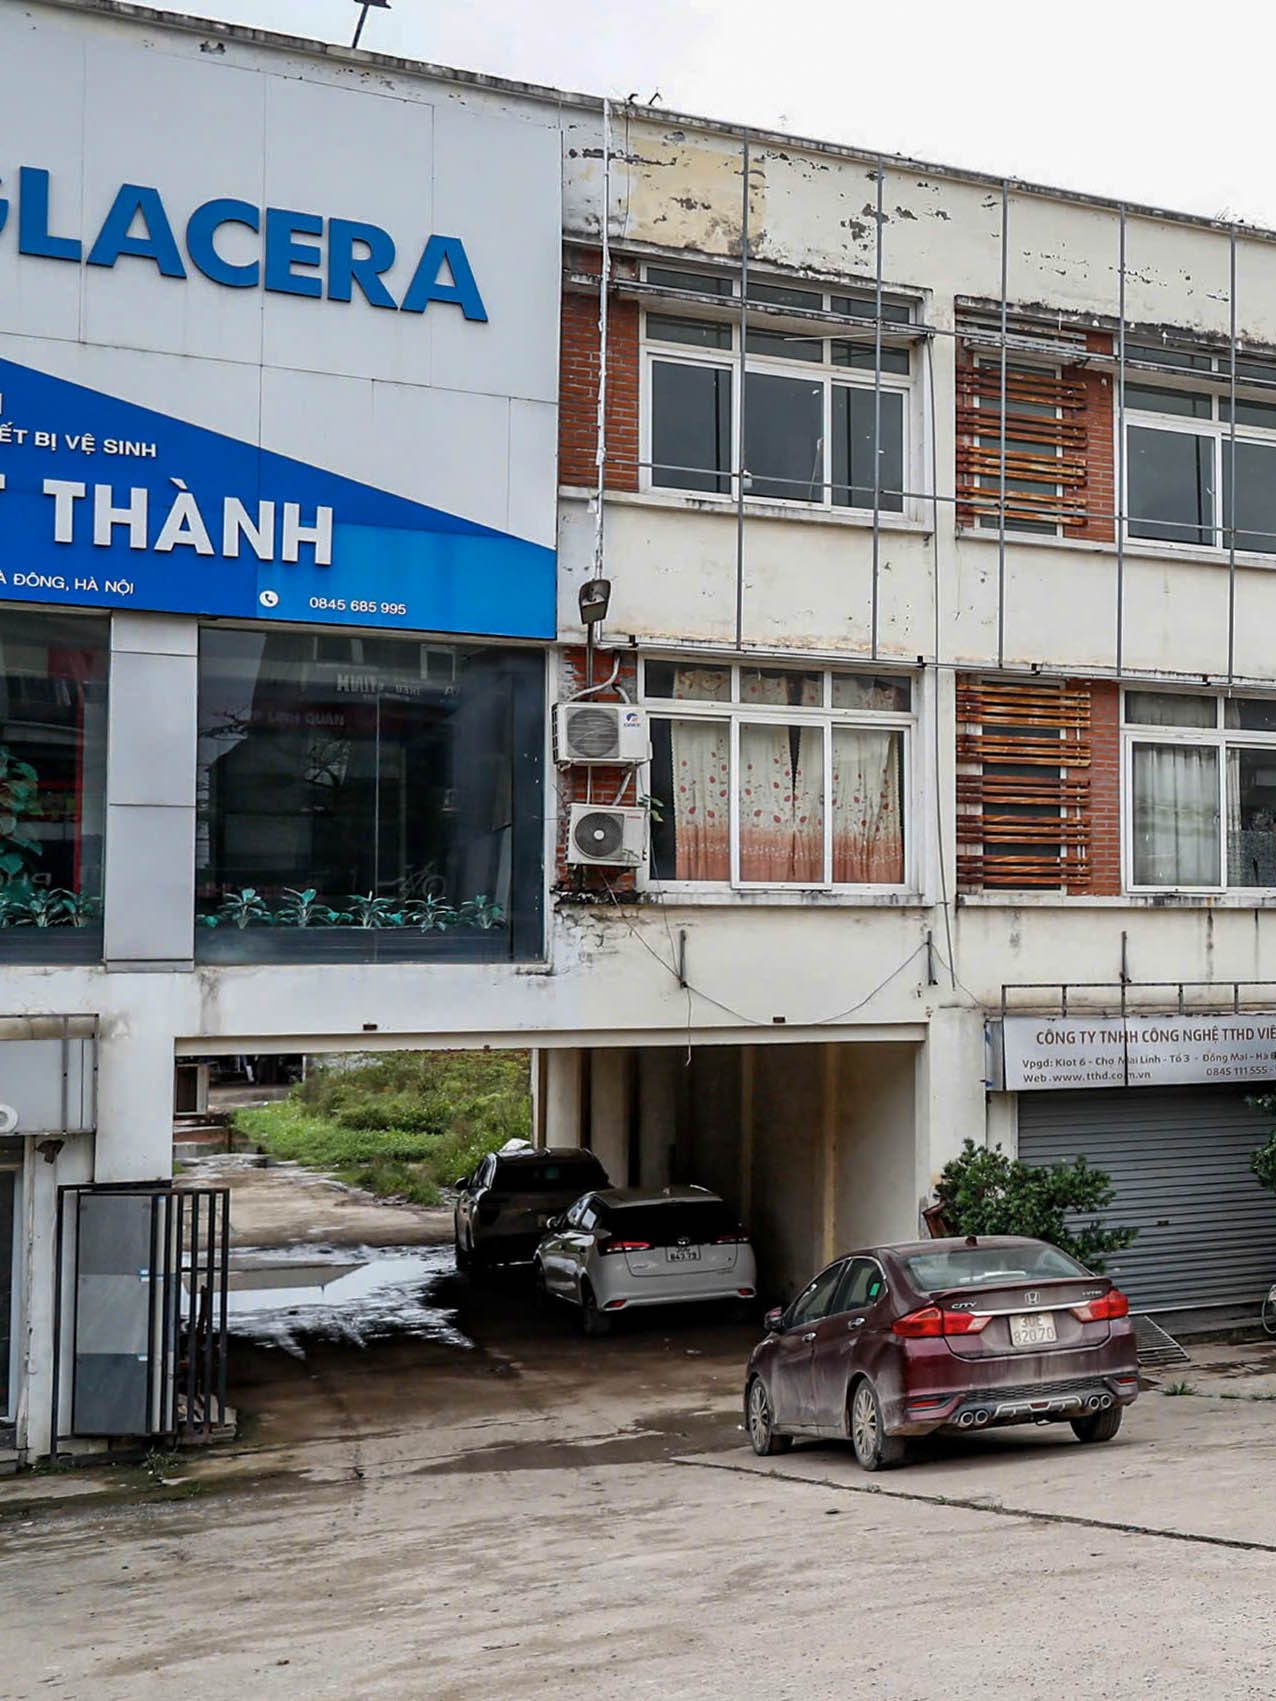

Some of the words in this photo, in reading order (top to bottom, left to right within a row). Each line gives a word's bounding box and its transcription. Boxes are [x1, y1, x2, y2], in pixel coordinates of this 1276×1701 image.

[0, 166, 489, 323] LACERA
[34, 431, 57, 451] BỊ
[65, 433, 96, 455] VỆ
[103, 438, 157, 458] SINH
[43, 477, 334, 566] THÀNH
[13, 572, 70, 591] ĐÔNG,
[74, 576, 99, 592] HÀ
[105, 579, 134, 595] NỘI
[310, 597, 346, 611] 0845
[350, 600, 377, 613] 685
[381, 603, 407, 615] 995
[1036, 1028, 1076, 1045] CÔNG
[1080, 1030, 1097, 1044] TY
[1100, 1030, 1138, 1044] TNHH
[1142, 1027, 1179, 1043] CÔNG
[1183, 1025, 1218, 1044] NGHỆ
[1222, 1027, 1254, 1041] TTHD
[1184, 1053, 1190, 1063] 3
[1206, 1067, 1232, 1077] 0845
[1234, 1066, 1248, 1076] 111
[1250, 1065, 1268, 1075] 555
